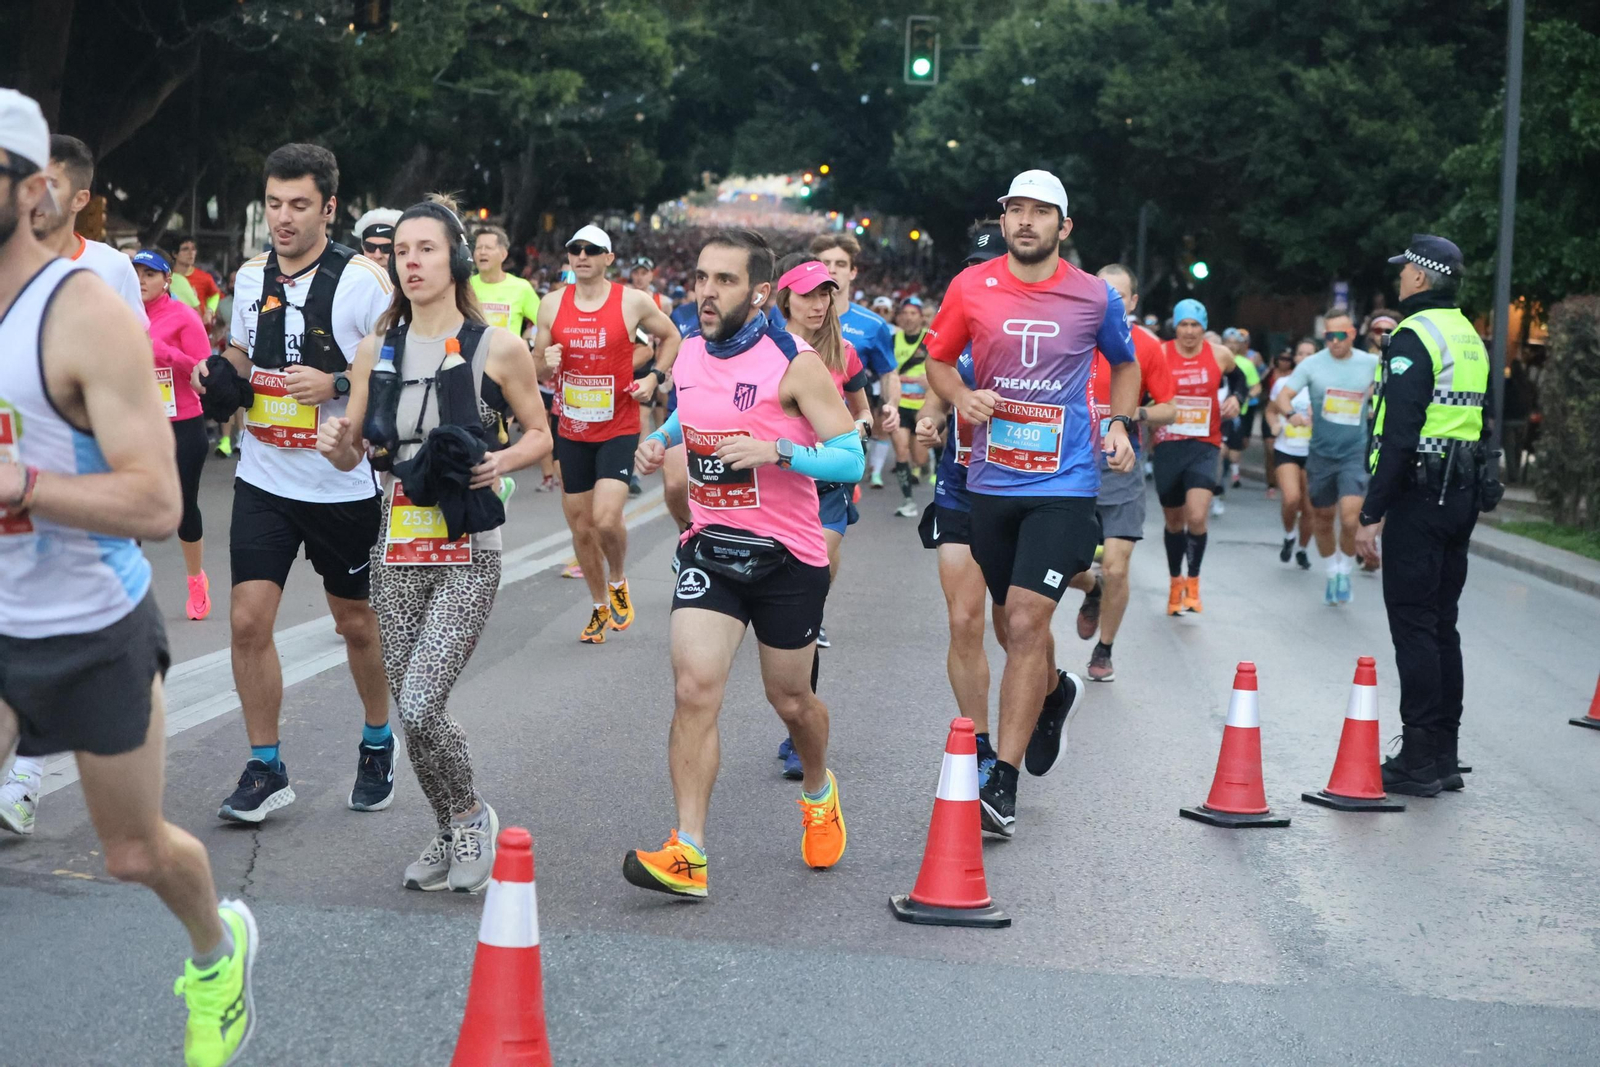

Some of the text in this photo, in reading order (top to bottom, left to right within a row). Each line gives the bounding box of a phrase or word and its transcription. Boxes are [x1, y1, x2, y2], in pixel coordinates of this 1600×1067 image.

[573, 377, 610, 386] GENERALI
[993, 376, 1063, 391] TRENARA
[571, 391, 603, 402] 14528
[263, 400, 298, 416] 1098
[1007, 404, 1058, 419] GENERALI
[1005, 424, 1041, 442] 7490
[697, 458, 725, 474] 123
[402, 509, 444, 526] 2537
[439, 543, 457, 551] 42K
